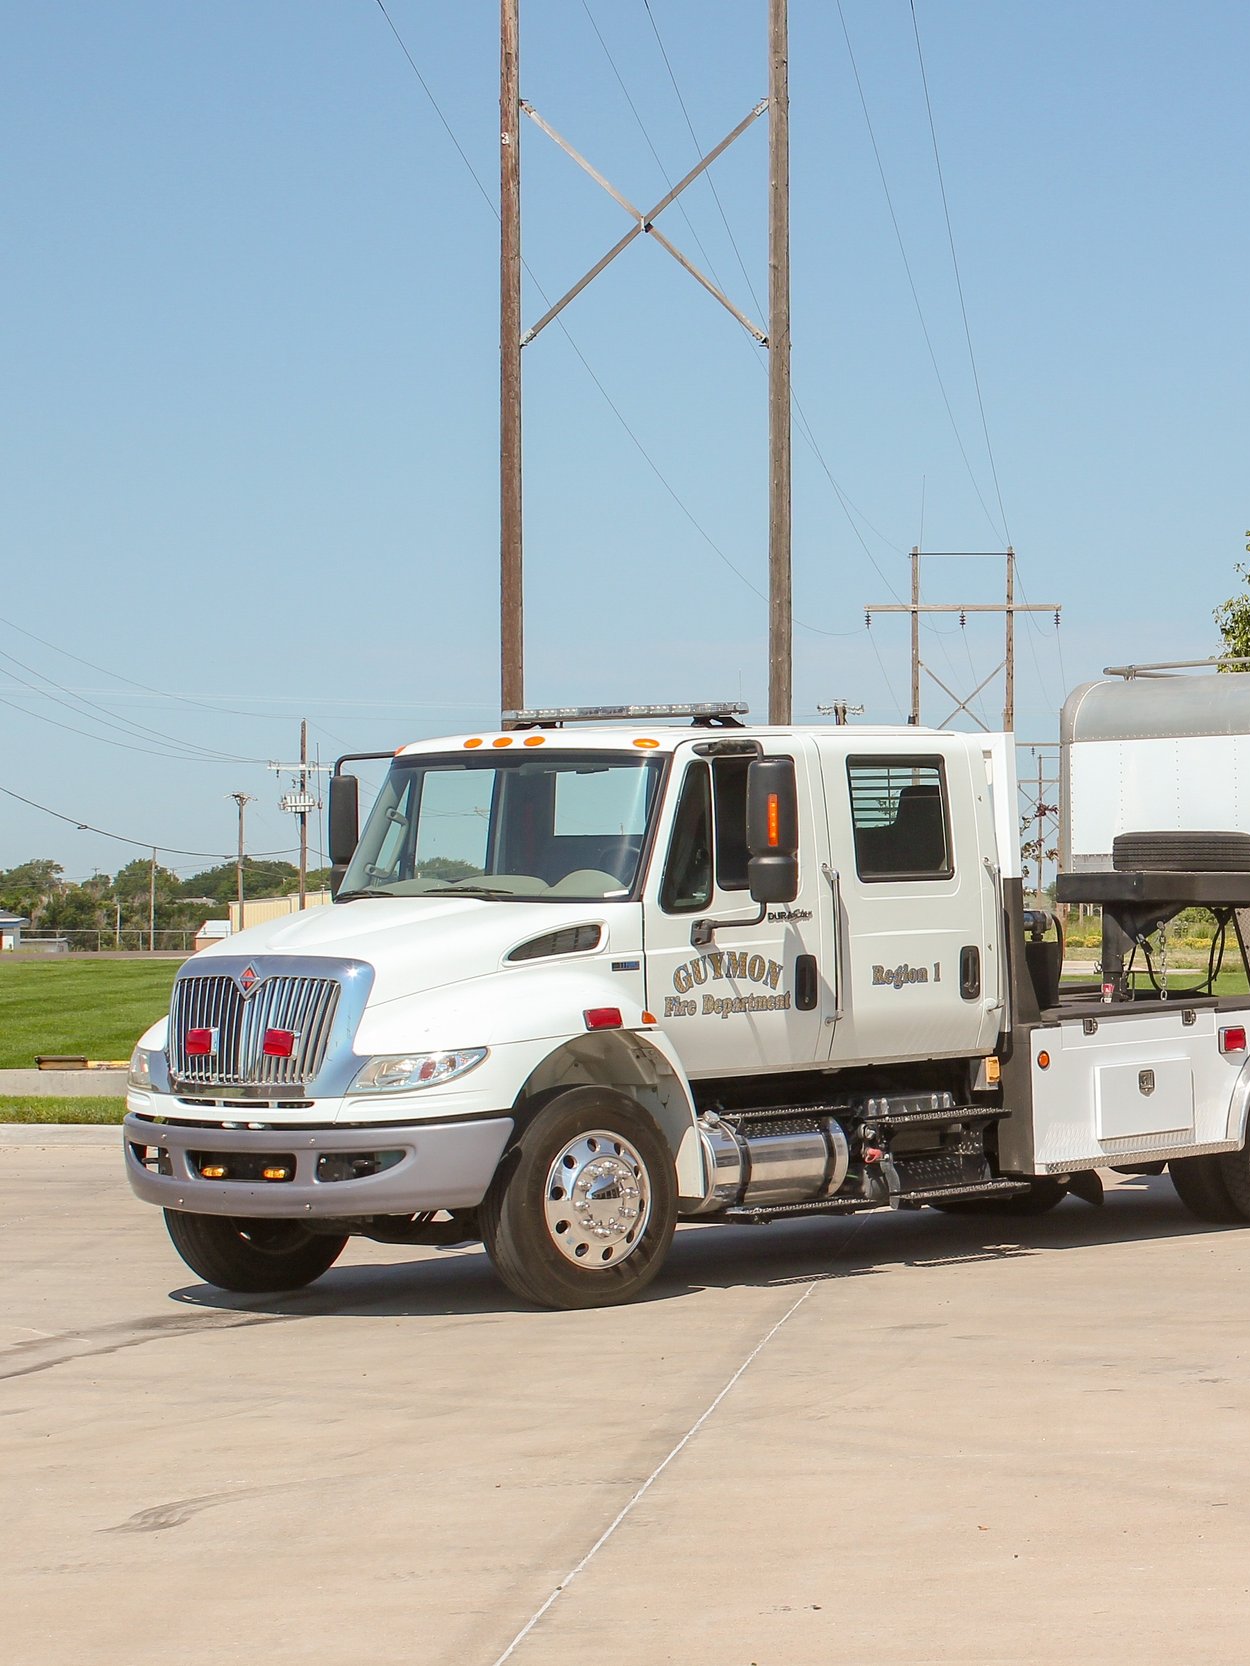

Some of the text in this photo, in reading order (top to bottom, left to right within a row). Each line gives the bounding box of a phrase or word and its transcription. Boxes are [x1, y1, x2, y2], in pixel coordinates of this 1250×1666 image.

[672, 950, 784, 994] GUYMON
[871, 961, 942, 990] Region 1
[664, 990, 792, 1019] Fire Department
